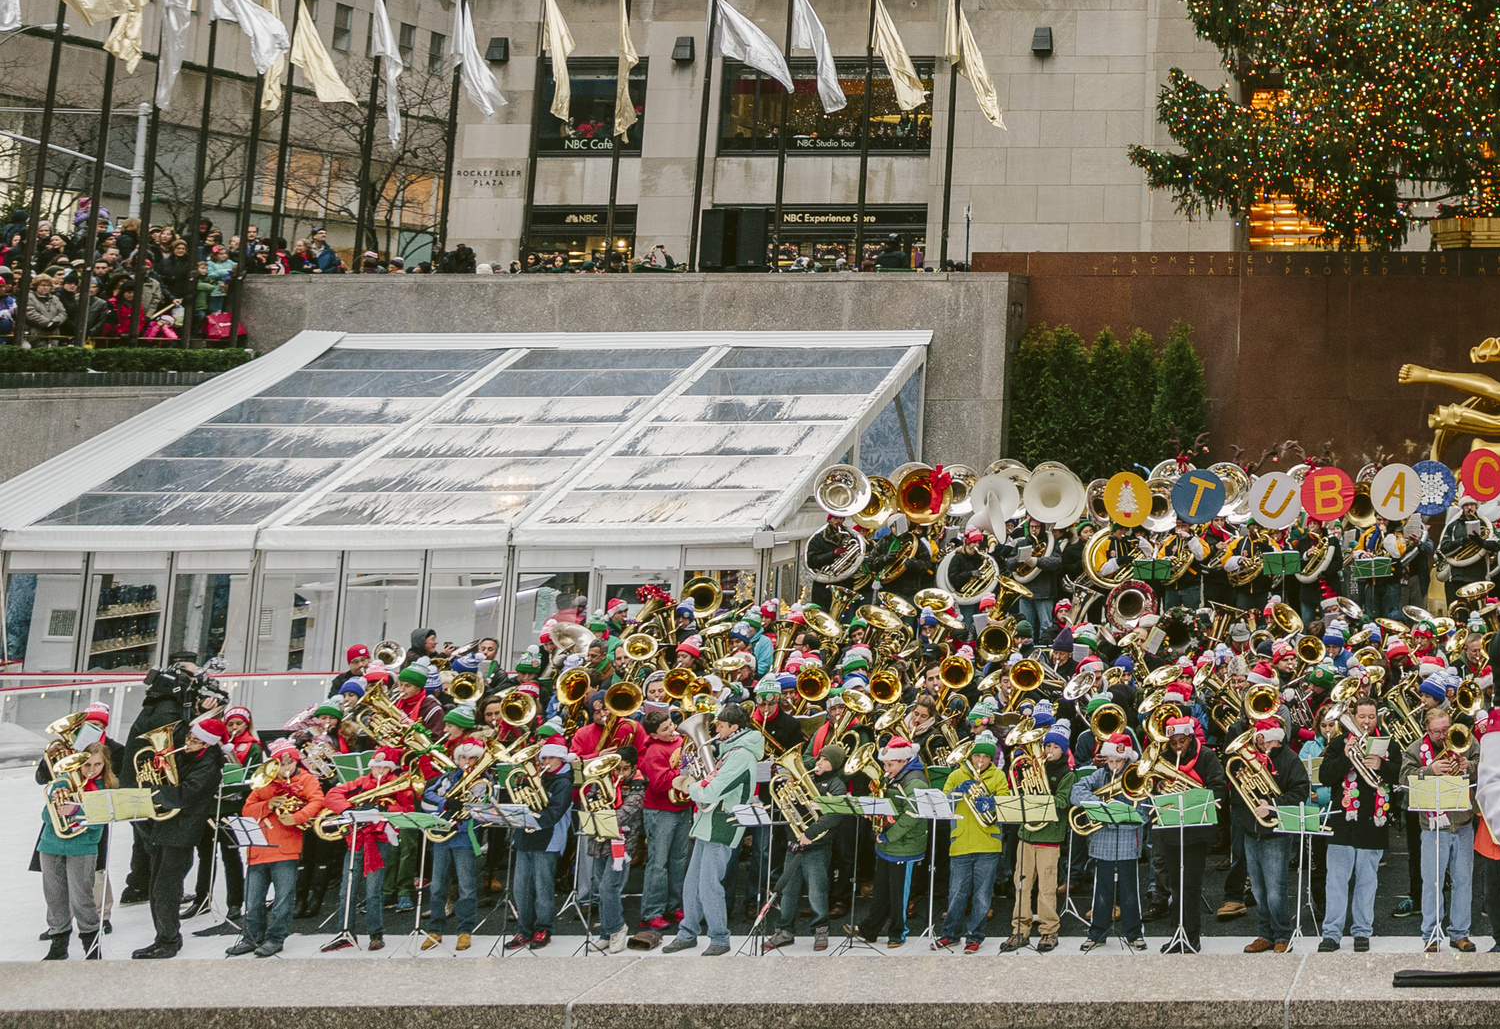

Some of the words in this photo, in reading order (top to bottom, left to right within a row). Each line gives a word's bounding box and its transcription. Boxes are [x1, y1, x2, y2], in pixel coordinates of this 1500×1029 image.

[565, 139, 588, 150] NBC
[797, 139, 814, 147] NBC
[816, 139, 838, 147] Studio
[839, 139, 856, 147] Tour
[579, 214, 598, 223] NBC
[783, 214, 802, 223] NBC
[804, 214, 851, 224] Experience
[853, 214, 876, 223] Sore
[1324, 255, 1446, 264] TEACHER
[1093, 267, 1156, 275] THAT
[1189, 267, 1253, 275] HATH
[1285, 267, 1388, 275] PROVED
[1421, 267, 1448, 275] TO
